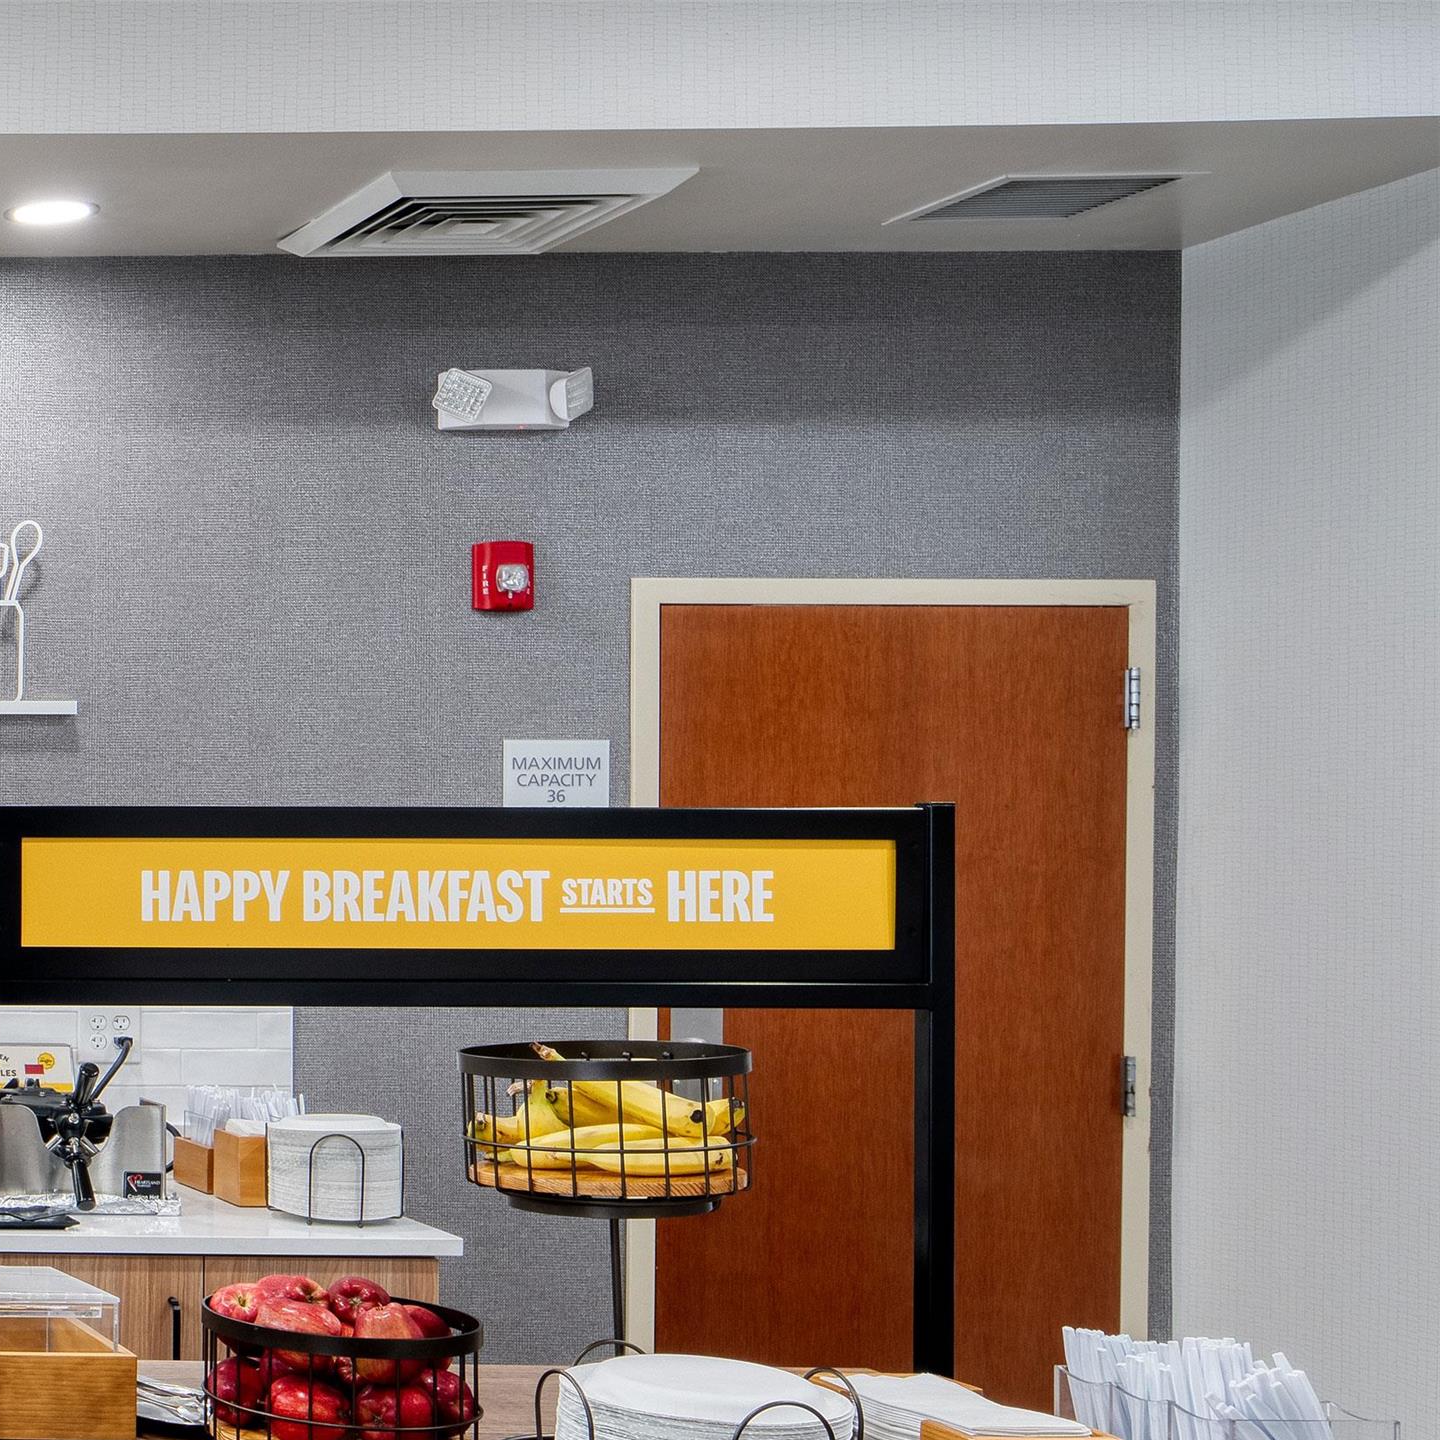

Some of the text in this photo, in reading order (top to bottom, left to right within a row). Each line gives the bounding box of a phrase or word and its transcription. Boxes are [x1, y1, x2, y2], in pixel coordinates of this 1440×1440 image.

[512, 757, 601, 770] MAXIMUM
[517, 773, 597, 787] CAPACITY
[547, 789, 566, 803] 36
[141, 869, 774, 923] HAPPY BREAKFAST STARTS HERE
